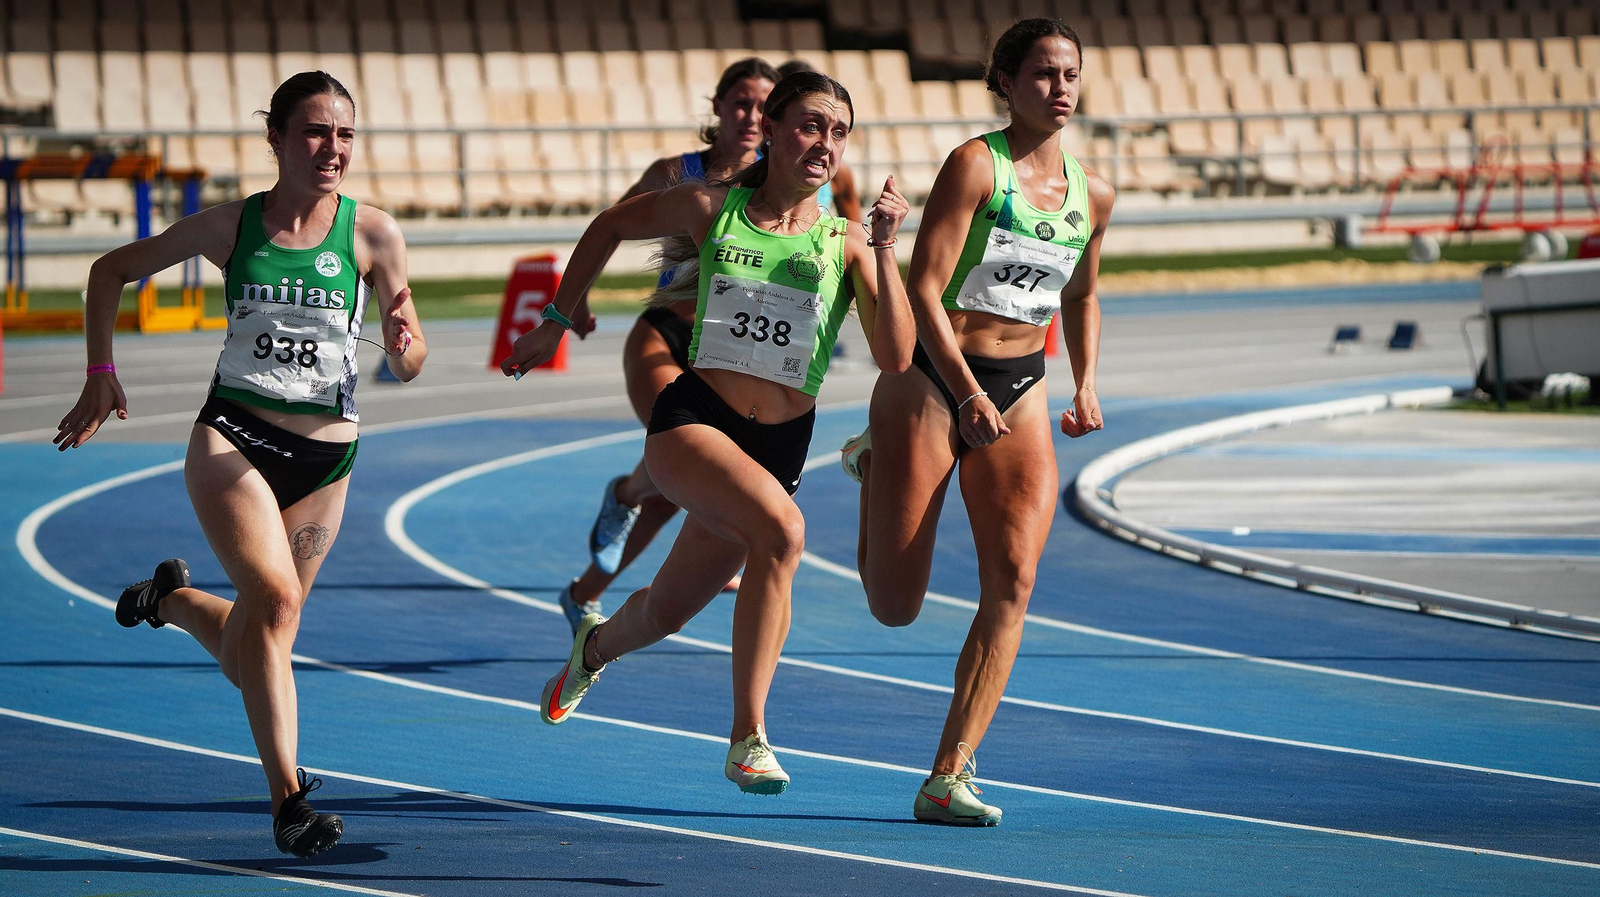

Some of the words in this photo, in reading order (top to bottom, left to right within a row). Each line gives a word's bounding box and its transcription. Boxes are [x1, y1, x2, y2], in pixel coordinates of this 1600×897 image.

[713, 245, 764, 268] ÉLITE
[728, 244, 764, 256] NEUMÁTICOS
[241, 277, 346, 309] mijas
[994, 264, 1051, 292] 327
[729, 312, 792, 347] 338
[253, 332, 318, 368] 938
